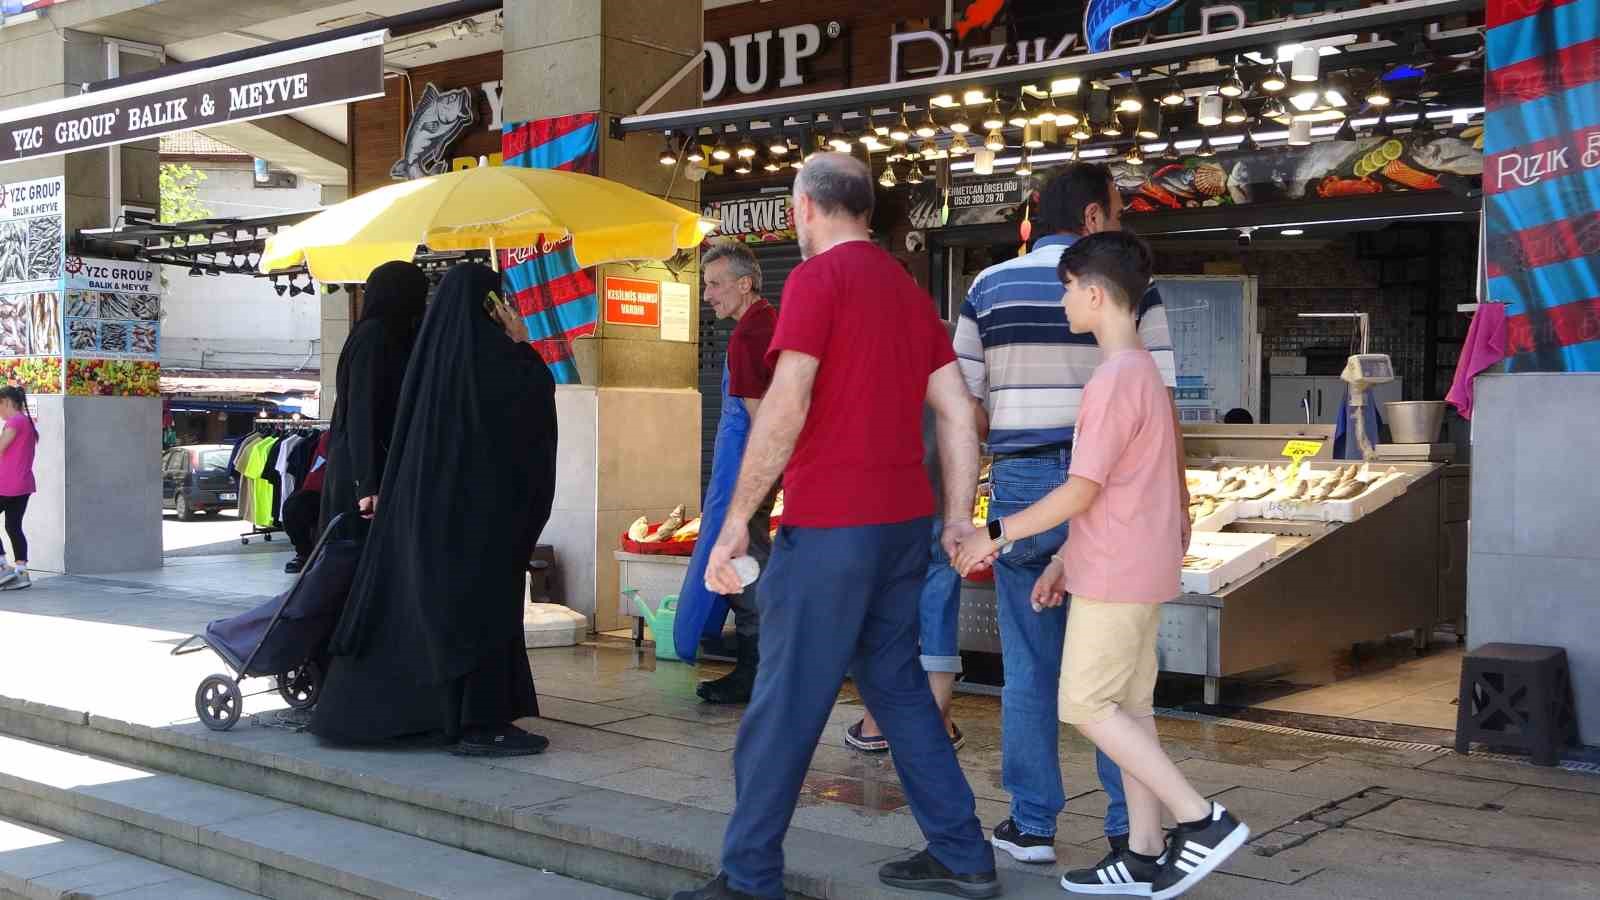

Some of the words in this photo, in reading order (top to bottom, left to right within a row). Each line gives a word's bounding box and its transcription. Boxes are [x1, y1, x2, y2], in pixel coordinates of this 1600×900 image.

[703, 24, 820, 101] OUP
[12, 126, 43, 151] YZC
[55, 112, 116, 144] GROUP
[128, 97, 188, 131] BALIK
[200, 93, 215, 116] &
[229, 73, 308, 111] MEYVE
[1497, 146, 1569, 189] RIZIK
[10, 186, 26, 203] YZC
[29, 181, 61, 200] GROUP
[948, 183, 983, 197] EHMETCAN
[994, 192, 1004, 202] 70
[12, 205, 29, 217] BALIK
[36, 202, 58, 212] MEYVE
[720, 199, 788, 235] MEYVE
[86, 266, 109, 278] YZC
[112, 268, 152, 281] GROUP
[89, 281, 113, 289] BALIK
[114, 281, 120, 290] &
[121, 282, 149, 292] MEYVE
